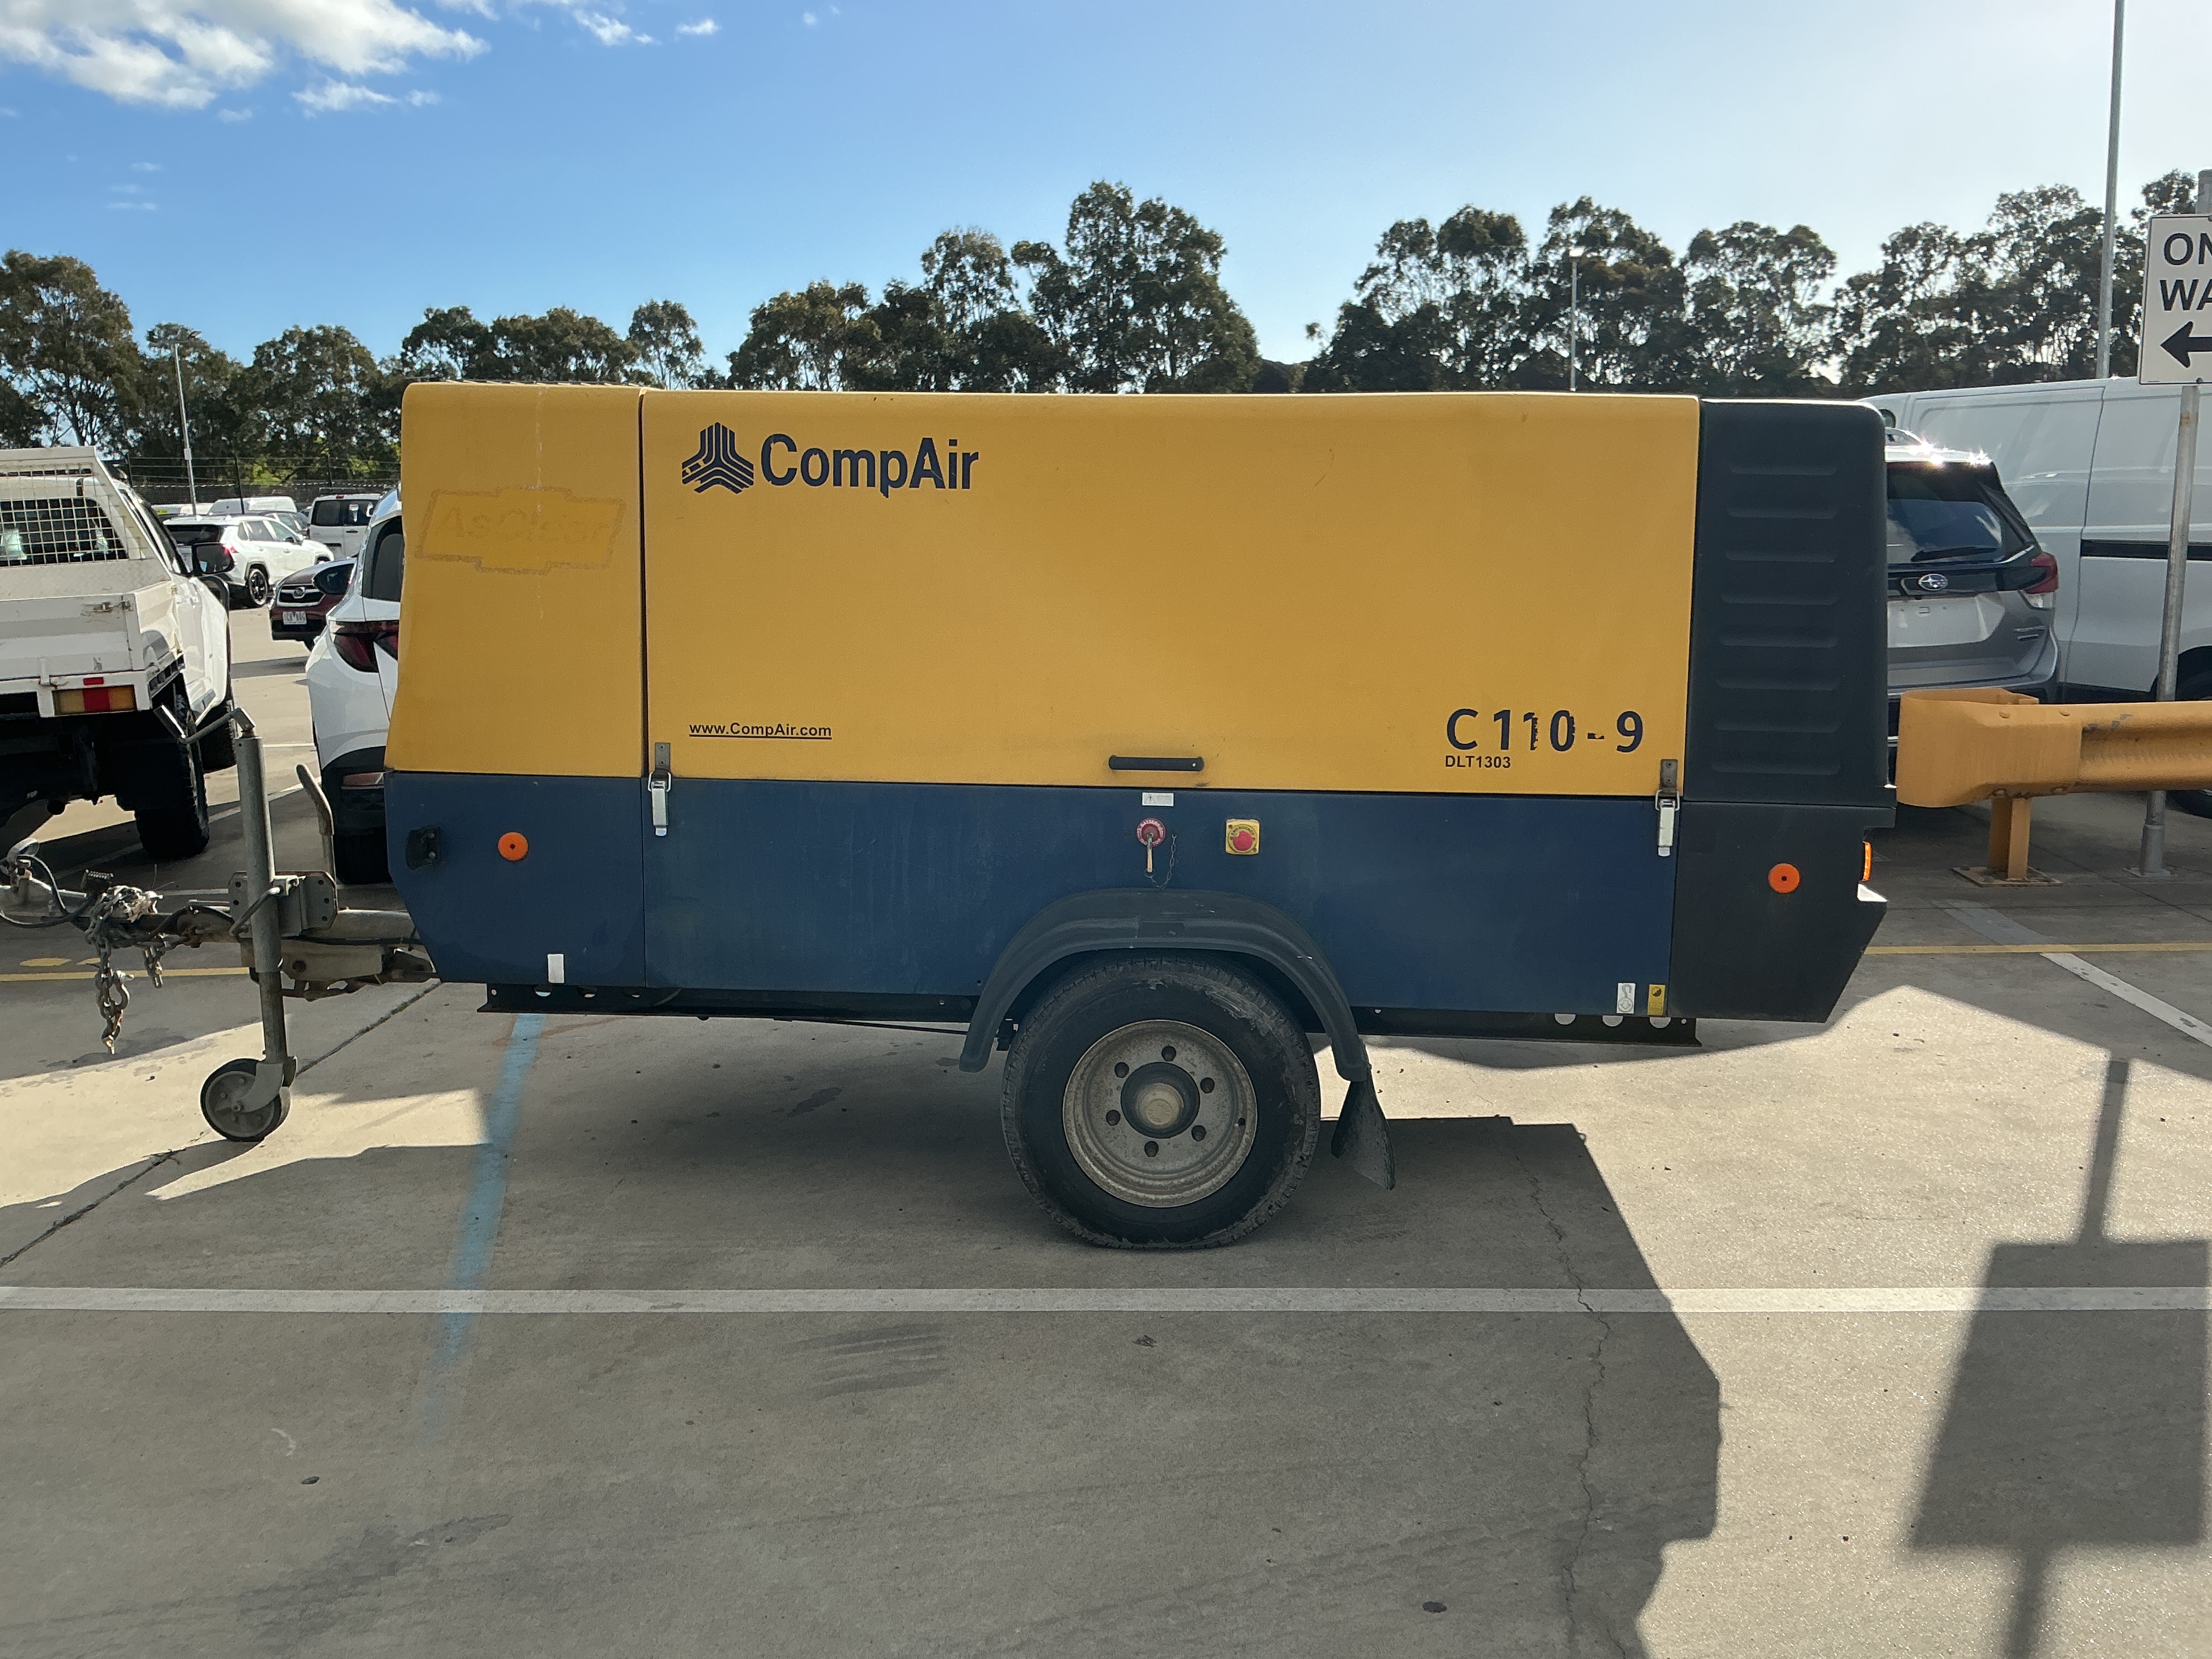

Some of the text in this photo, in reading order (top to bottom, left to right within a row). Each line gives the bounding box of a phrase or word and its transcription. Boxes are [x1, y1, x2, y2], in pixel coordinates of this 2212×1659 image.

[761, 433, 979, 498] CompAir
[689, 722, 832, 740] www.CompAir.com
[1445, 755, 1511, 769] DLT1303
